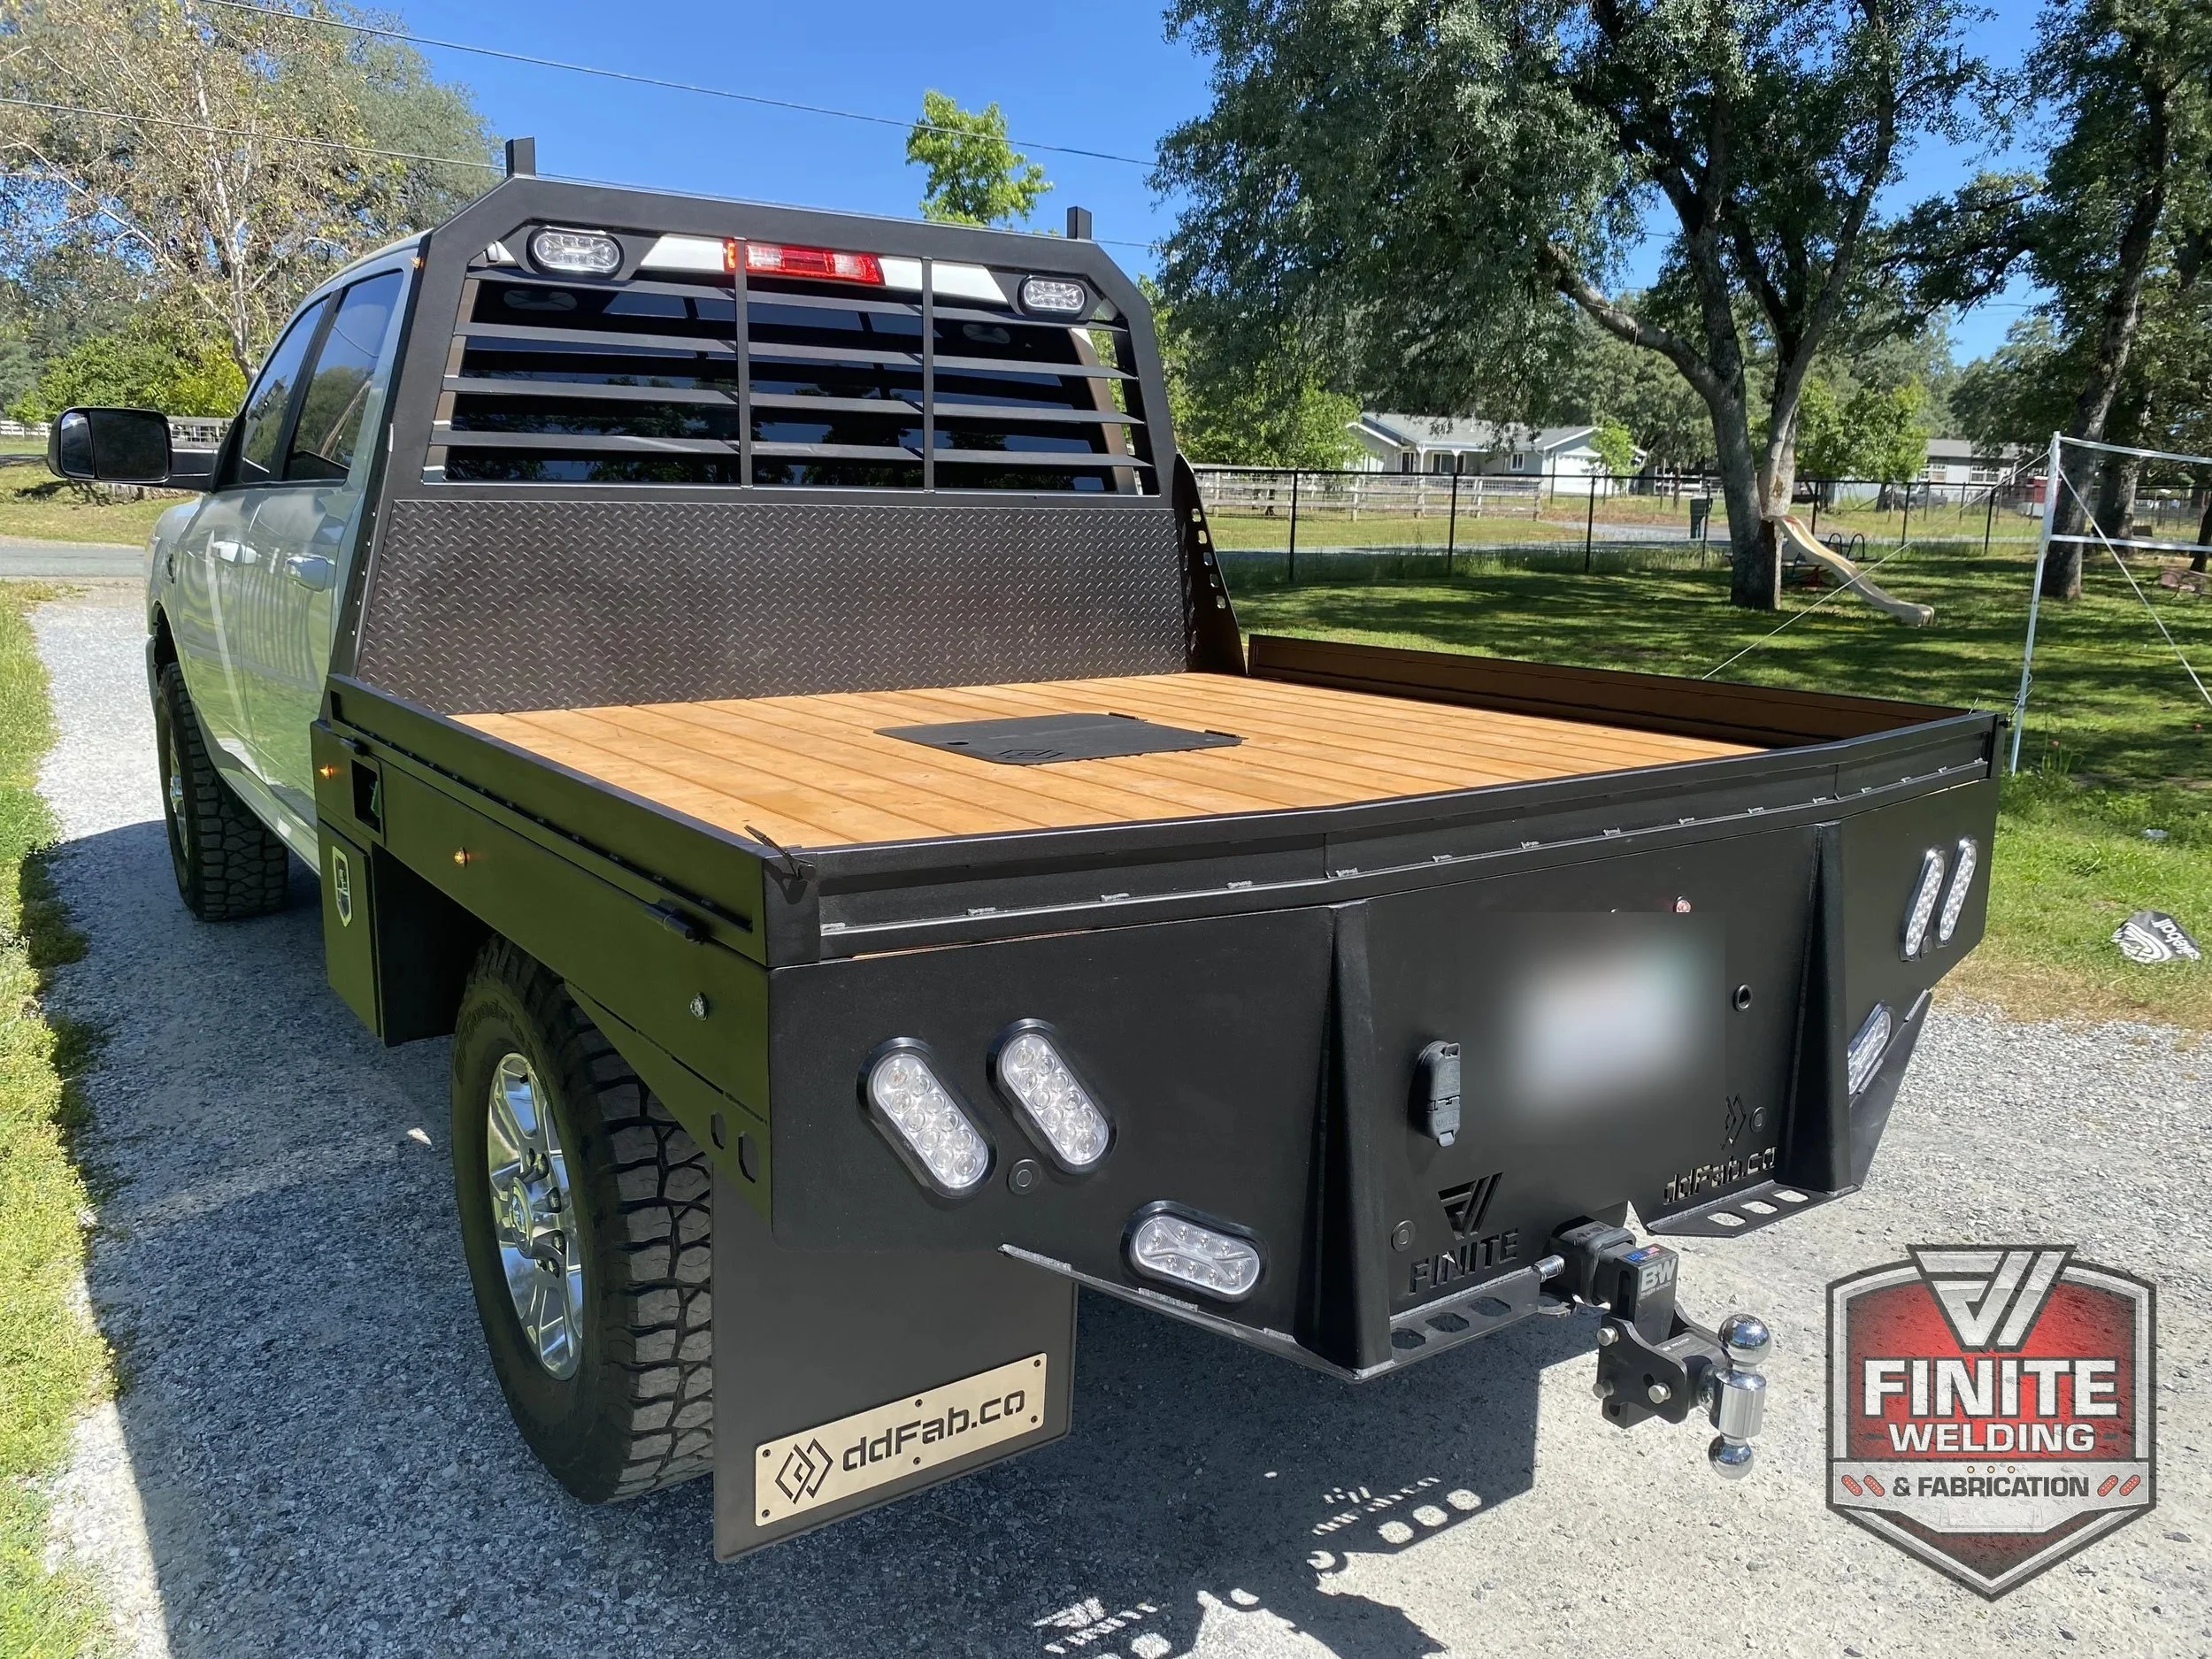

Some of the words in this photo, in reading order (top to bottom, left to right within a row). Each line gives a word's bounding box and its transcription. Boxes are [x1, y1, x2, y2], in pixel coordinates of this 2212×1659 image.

[1663, 1147, 1778, 1206] ddFab.co
[1409, 1227, 1518, 1296] FINITE
[842, 1389, 1025, 1472] ddFab.co
